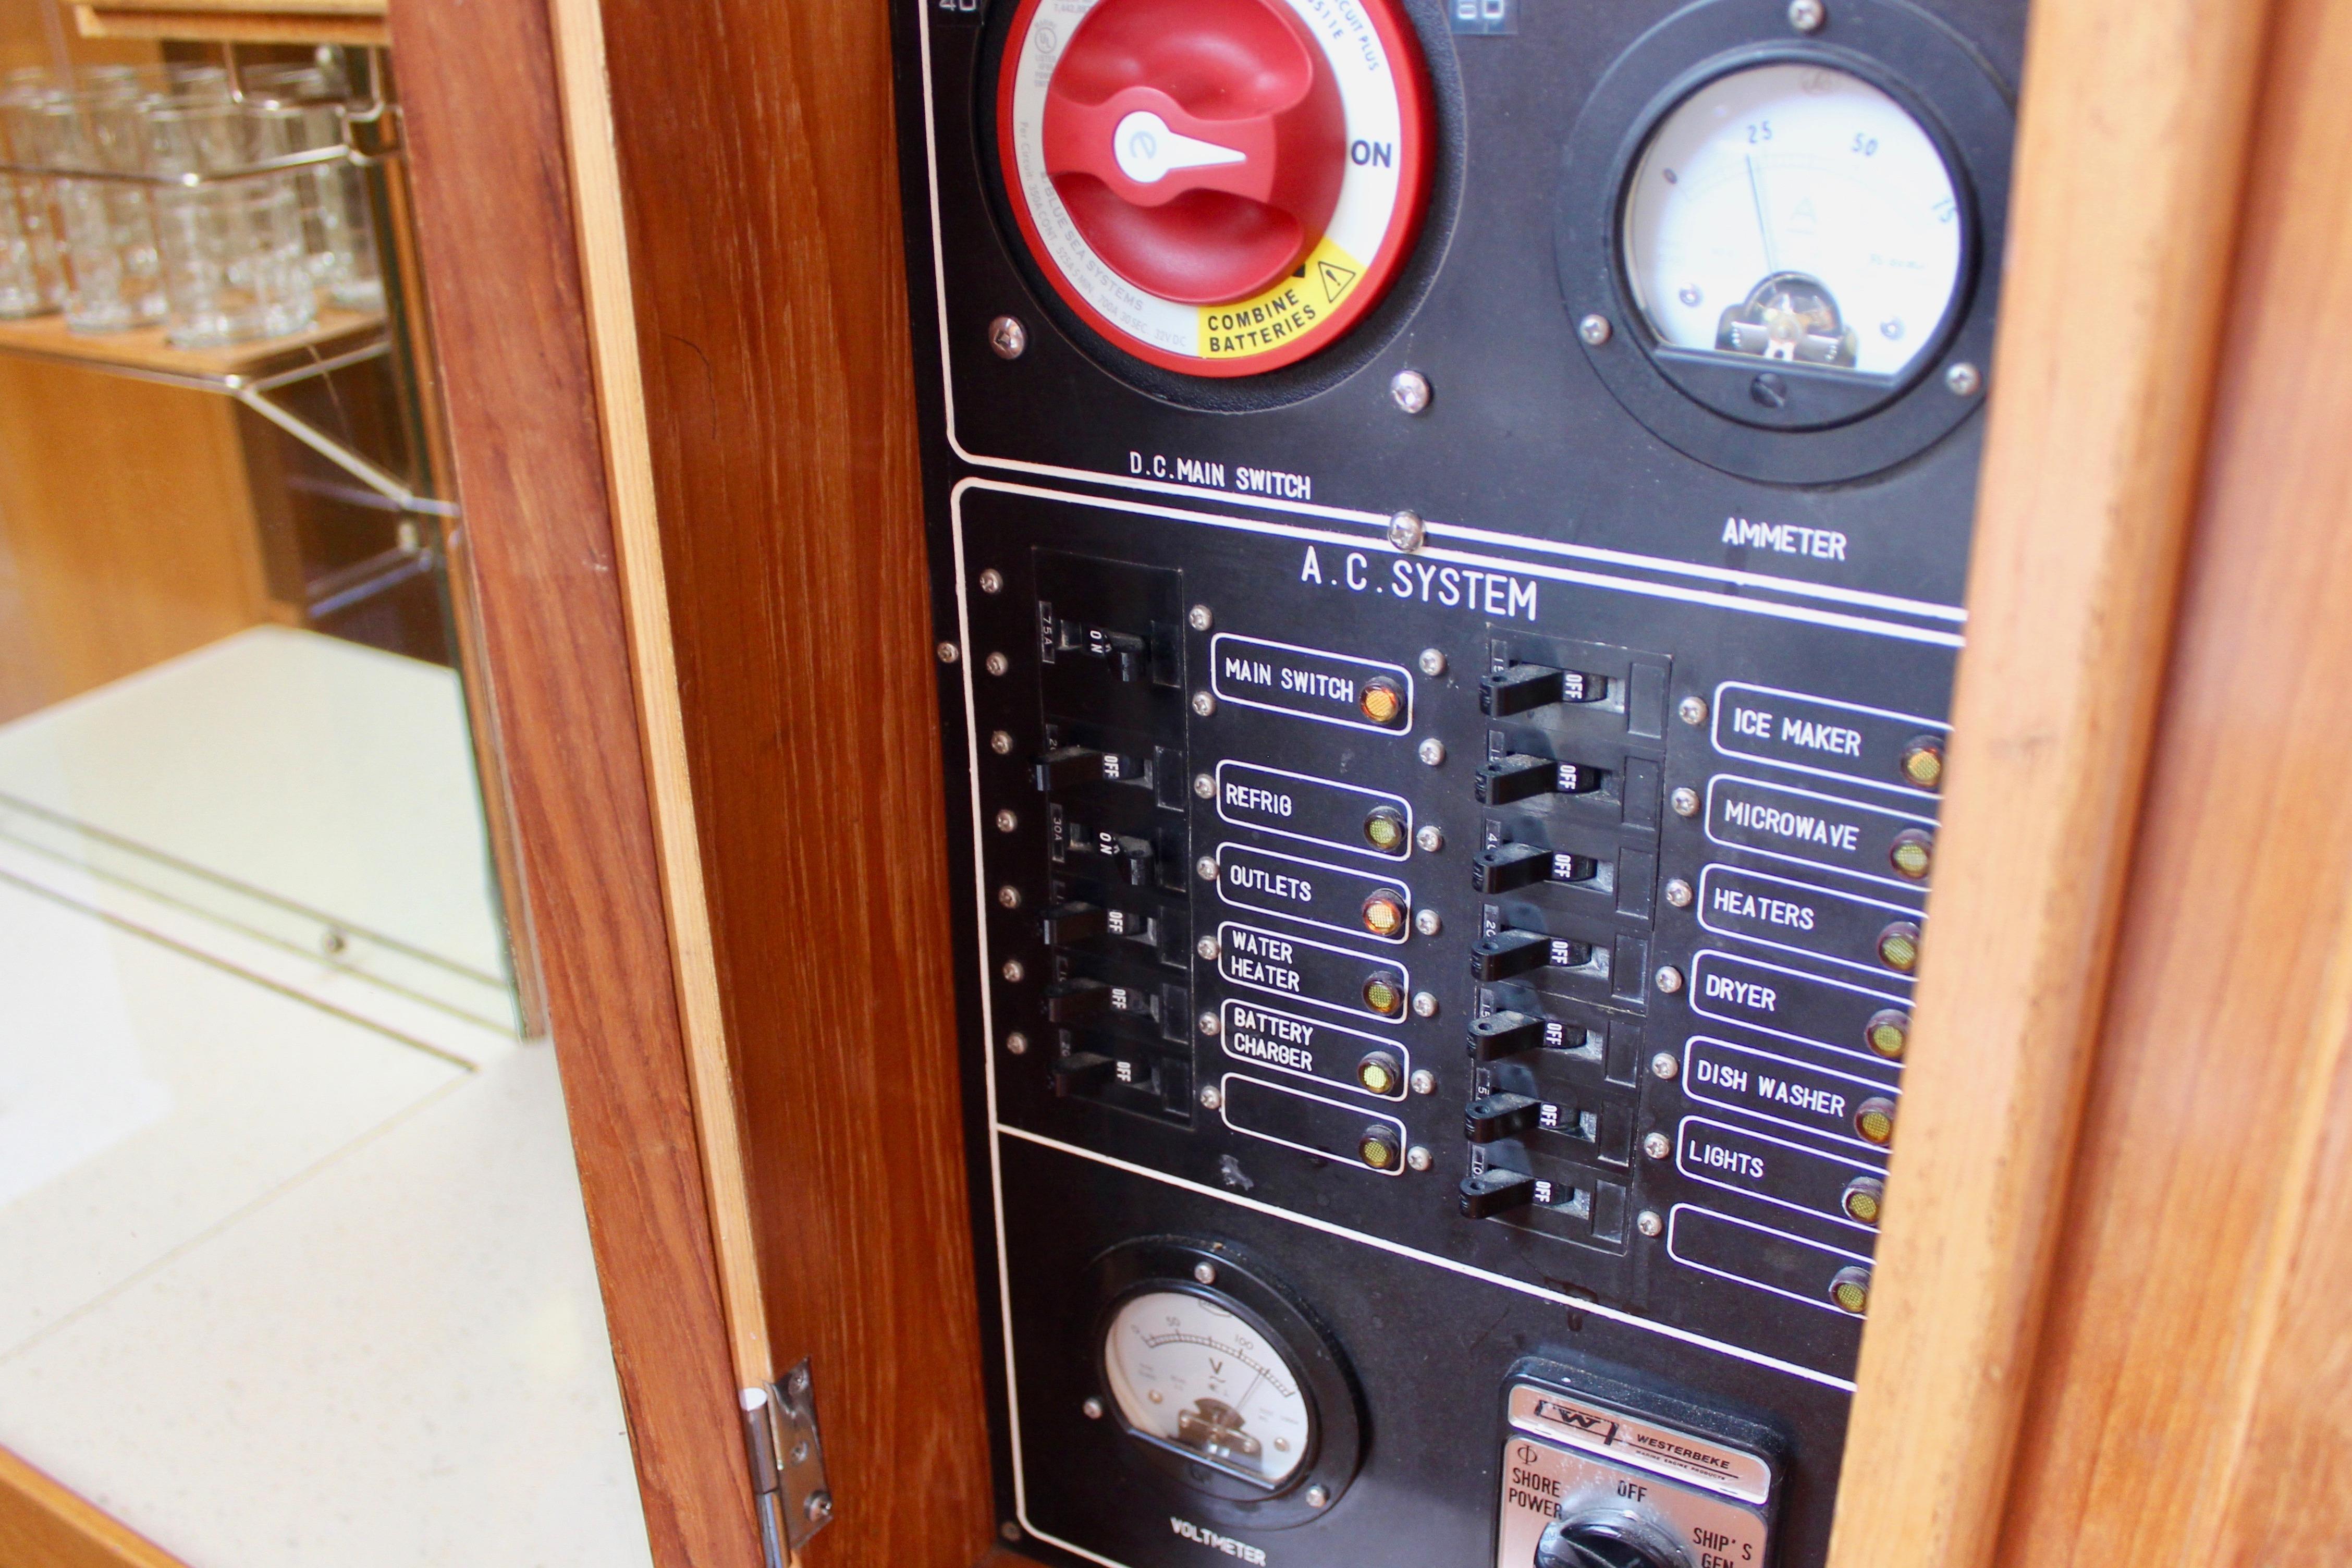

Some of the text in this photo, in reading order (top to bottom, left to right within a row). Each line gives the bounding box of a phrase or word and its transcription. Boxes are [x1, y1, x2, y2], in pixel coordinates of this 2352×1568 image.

[1334, 0, 1379, 71] CUIT PLUS
[1747, 120, 1772, 145] 25
[1851, 132, 1879, 157] 50
[1351, 139, 1391, 168] ON
[1662, 167, 1678, 185] 0
[1044, 187, 1144, 312] BLUE SEA SYSTEMS
[1207, 288, 1299, 331] COMBINE
[1209, 304, 1316, 352] BATTERIES
[1236, 467, 1312, 500] SWITCH
[1722, 517, 1847, 562] AMMETER
[1042, 616, 1053, 645] 75A
[1089, 629, 1103, 654] ON
[1225, 657, 1354, 703] MAIN SWITCH
[1565, 673, 1583, 700] OFF
[1733, 707, 1862, 757] ICE MAKER
[1103, 754, 1120, 778] OFF
[1559, 764, 1577, 790] OFF
[1226, 782, 1293, 817] REFRIG
[1052, 816, 1063, 841] 30A
[1724, 799, 1860, 851] MICROWAVE
[1099, 831, 1112, 855] ON
[1553, 853, 1572, 878] OFF
[1230, 864, 1312, 902] OUTLETS
[1108, 911, 1124, 935] OFF
[1713, 887, 1815, 930] HEATERS
[1232, 929, 1293, 965] WATER
[1551, 940, 1569, 965] OFF
[1231, 954, 1300, 993] HEATER
[1111, 988, 1127, 1010] OFF
[1705, 973, 1777, 1012] DRYER
[1234, 1007, 1314, 1046] BATTERY
[1546, 1022, 1562, 1046] OFF
[1233, 1032, 1313, 1072] CHARGER
[1116, 1061, 1131, 1083] OFF
[1696, 1059, 1845, 1118] DISH WASHER
[1539, 1103, 1558, 1127] OFF
[1688, 1140, 1765, 1179] LIGHTS
[1533, 1180, 1551, 1204] OFF
[1166, 1316, 1181, 1328] 50
[1235, 1334, 1254, 1350] 100
[1209, 1356, 1223, 1375] V
[1637, 1434, 1731, 1470] WESTERBEKE
[1512, 1467, 1561, 1499] SHORE
[1664, 1458, 1688, 1469] ENGINE
[1691, 1466, 1725, 1481] PRODUCTS
[1509, 1487, 1563, 1520] POWER
[1617, 1479, 1648, 1503] OFF
[1170, 1516, 1267, 1567] VOLTMETER
